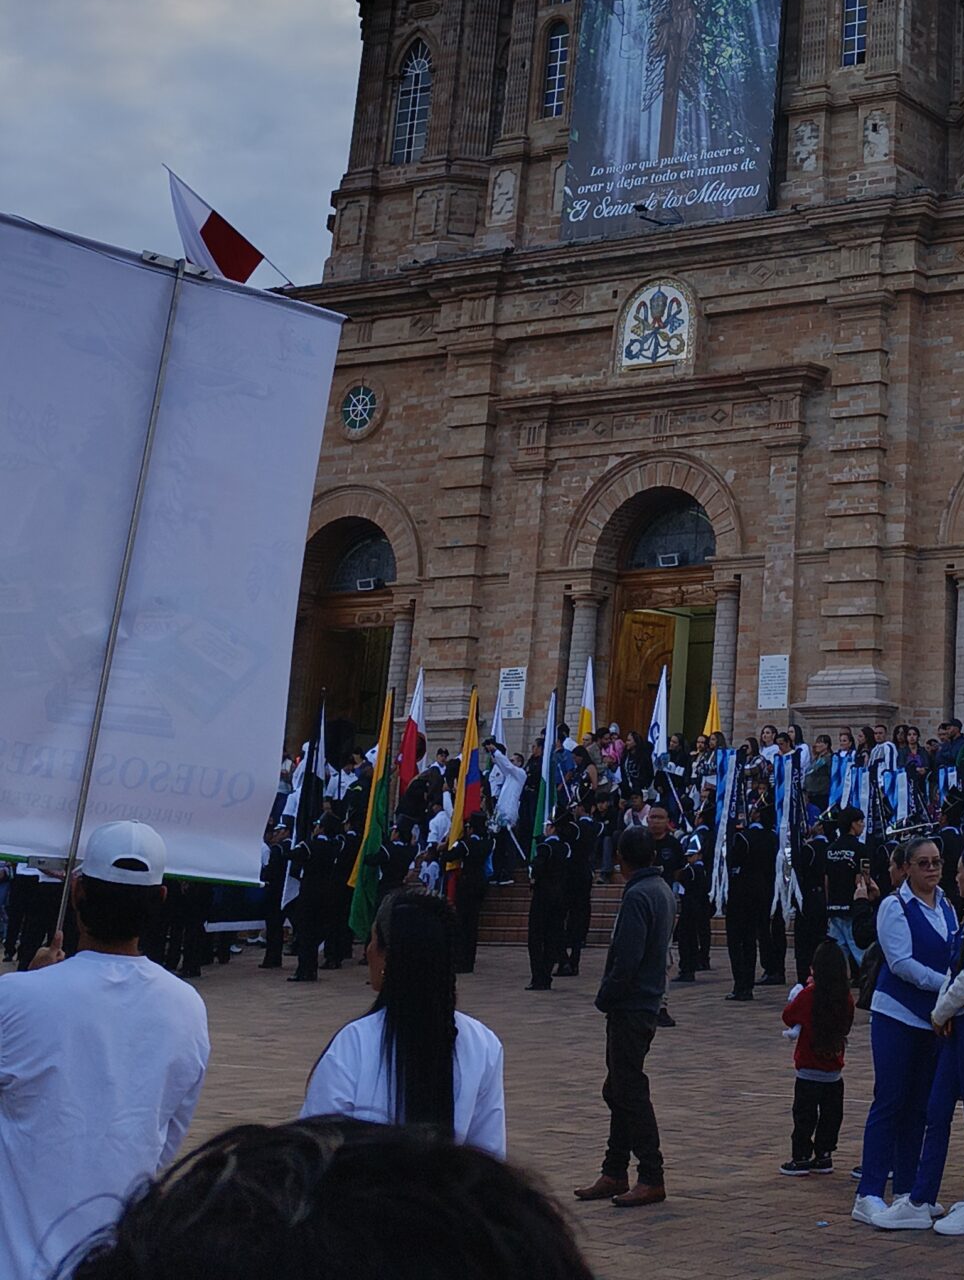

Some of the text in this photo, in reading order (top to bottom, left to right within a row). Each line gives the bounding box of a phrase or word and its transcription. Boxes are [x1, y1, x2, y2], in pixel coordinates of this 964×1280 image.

[577, 158, 755, 194] orar y dejar todo en manos de
[590, 145, 745, 177] Lo mejor que puedes hacer es
[569, 200, 591, 222] El
[662, 189, 684, 209] los
[685, 180, 761, 207] Milagros
